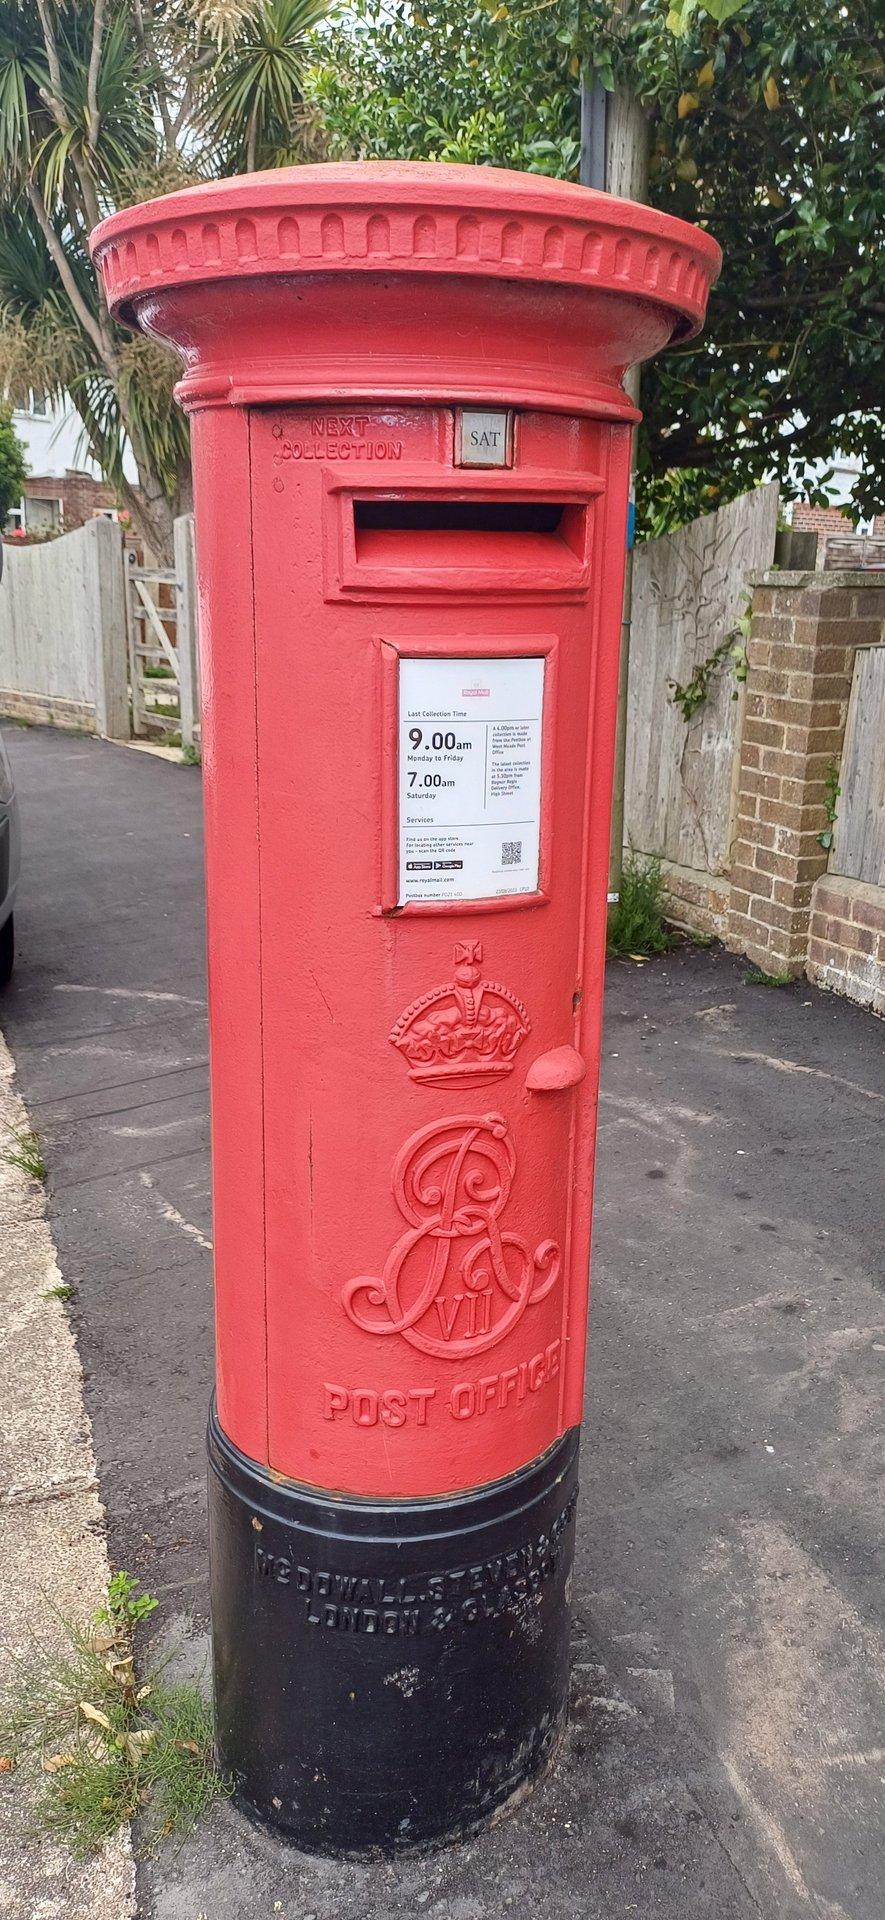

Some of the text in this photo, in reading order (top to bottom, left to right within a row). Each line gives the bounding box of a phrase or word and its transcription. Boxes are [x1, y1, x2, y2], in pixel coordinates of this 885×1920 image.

[311, 416, 370, 437] NEXT
[470, 431, 501, 447] SAT
[282, 440, 403, 460] COLLECTION
[409, 728, 472, 750] 9.00am
[407, 772, 455, 787] 7.00am
[435, 1289, 493, 1341] VII
[323, 1339, 562, 1428] POST OFFICE
[305, 1599, 420, 1636] LONDON
